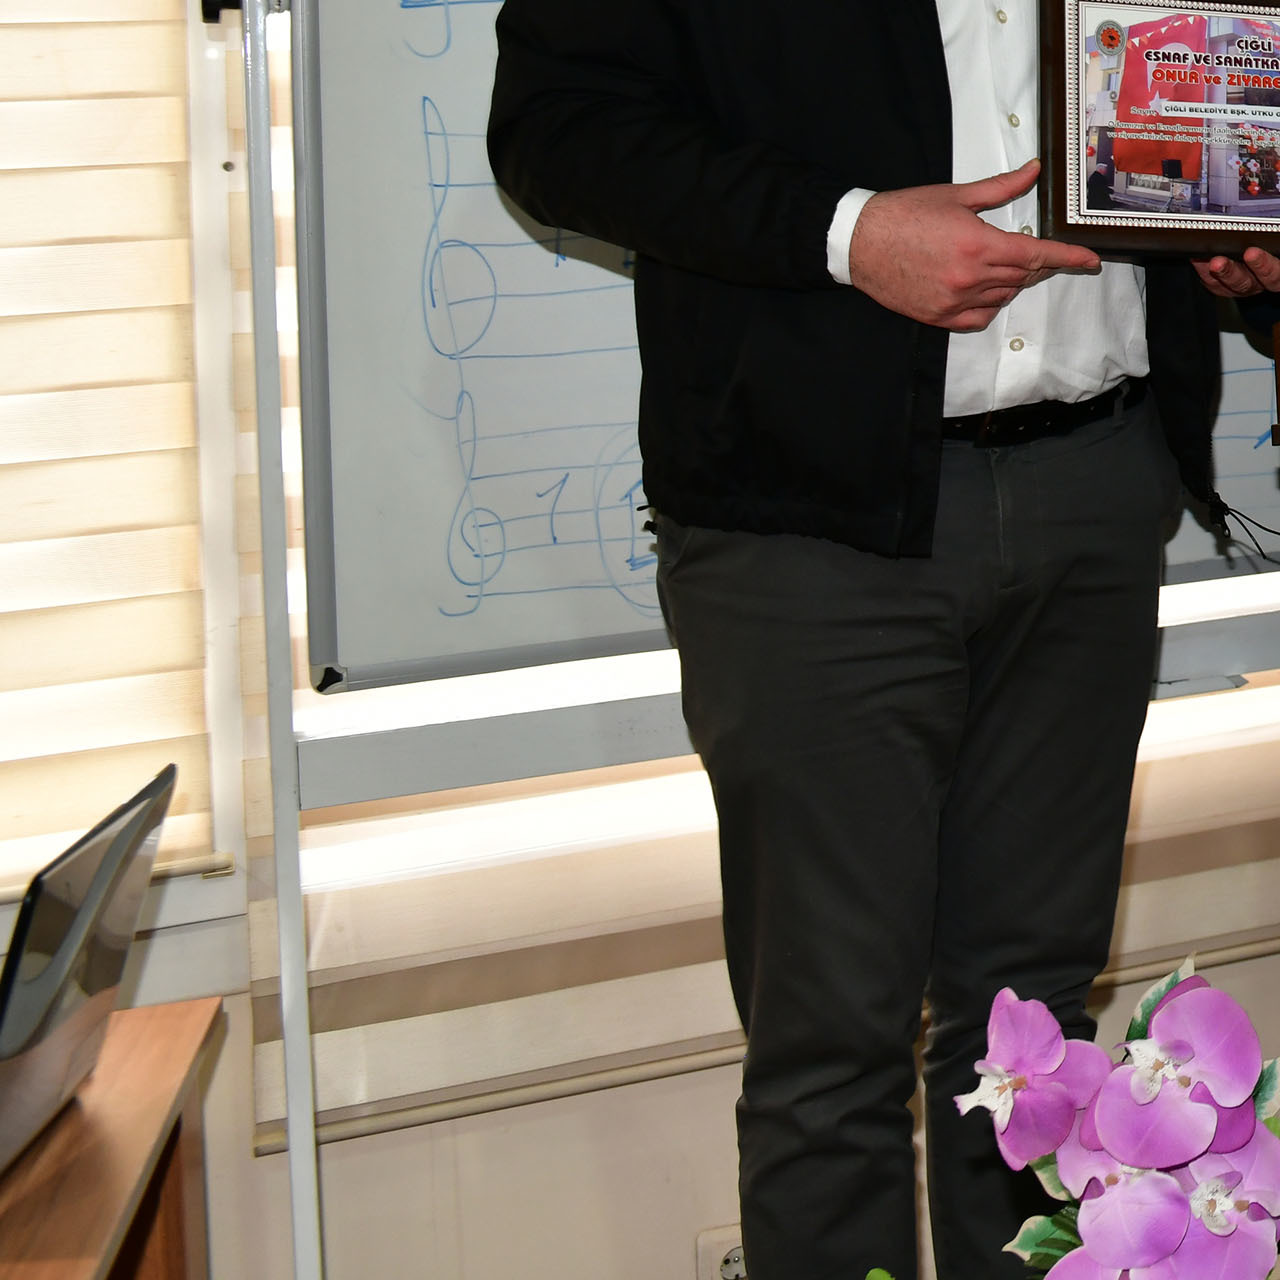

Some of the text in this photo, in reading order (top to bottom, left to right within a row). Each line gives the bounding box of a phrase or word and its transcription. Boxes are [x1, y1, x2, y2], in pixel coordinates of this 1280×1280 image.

[1236, 35, 1272, 53] ÇİĞLİ
[1144, 50, 1190, 63] ESNAF
[1193, 54, 1211, 65] VE
[1152, 69, 1199, 84] ONUR
[1203, 75, 1222, 85] ve
[1164, 104, 1187, 114] ÇİĞLİ
[1188, 106, 1228, 115] BELEDİYE
[1251, 109, 1274, 117] UTKU
